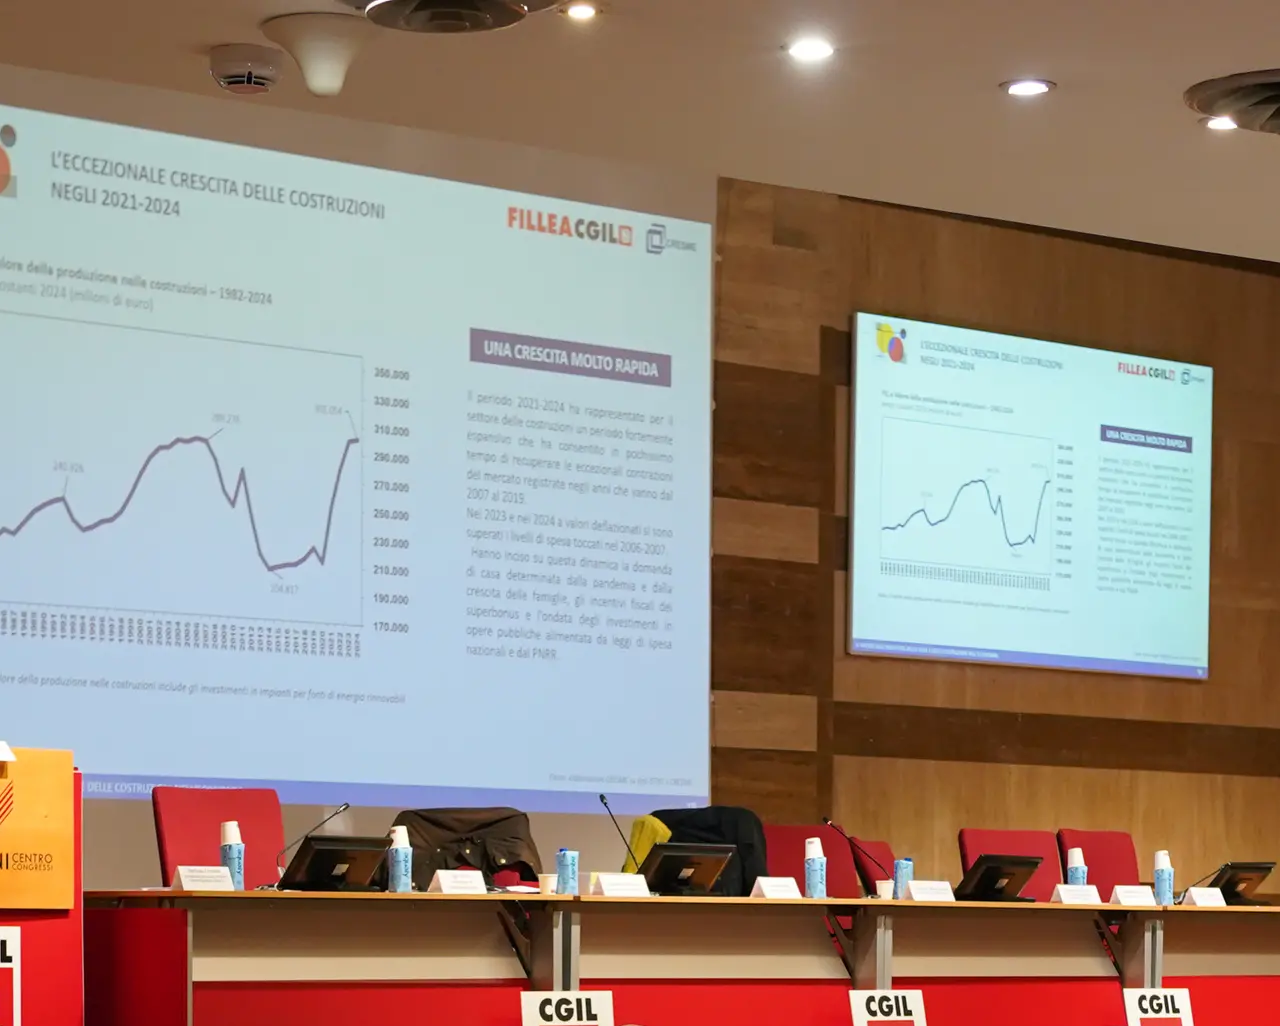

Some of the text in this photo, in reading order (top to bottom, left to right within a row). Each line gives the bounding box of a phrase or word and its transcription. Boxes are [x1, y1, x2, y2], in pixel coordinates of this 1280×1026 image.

[51, 152, 385, 219] L'ECCEZIONALE CRESCITA DELLE COSTRUZIONI
[51, 183, 179, 216] NEGLI 2021-2024
[27, 261, 53, 276] della
[57, 267, 117, 284] produzione
[122, 275, 146, 288] nelle
[150, 279, 206, 296] costruzioni
[219, 286, 272, 304] 1982-2024
[484, 341, 658, 377] UNA CRESCITA MOLTO RAPIDA
[88, 781, 112, 793] DELLE
[12, 853, 52, 863] CENTRO
[539, 998, 597, 1022] CGIL
[866, 996, 913, 1017] CGIL
[1138, 995, 1180, 1014] CGIL
